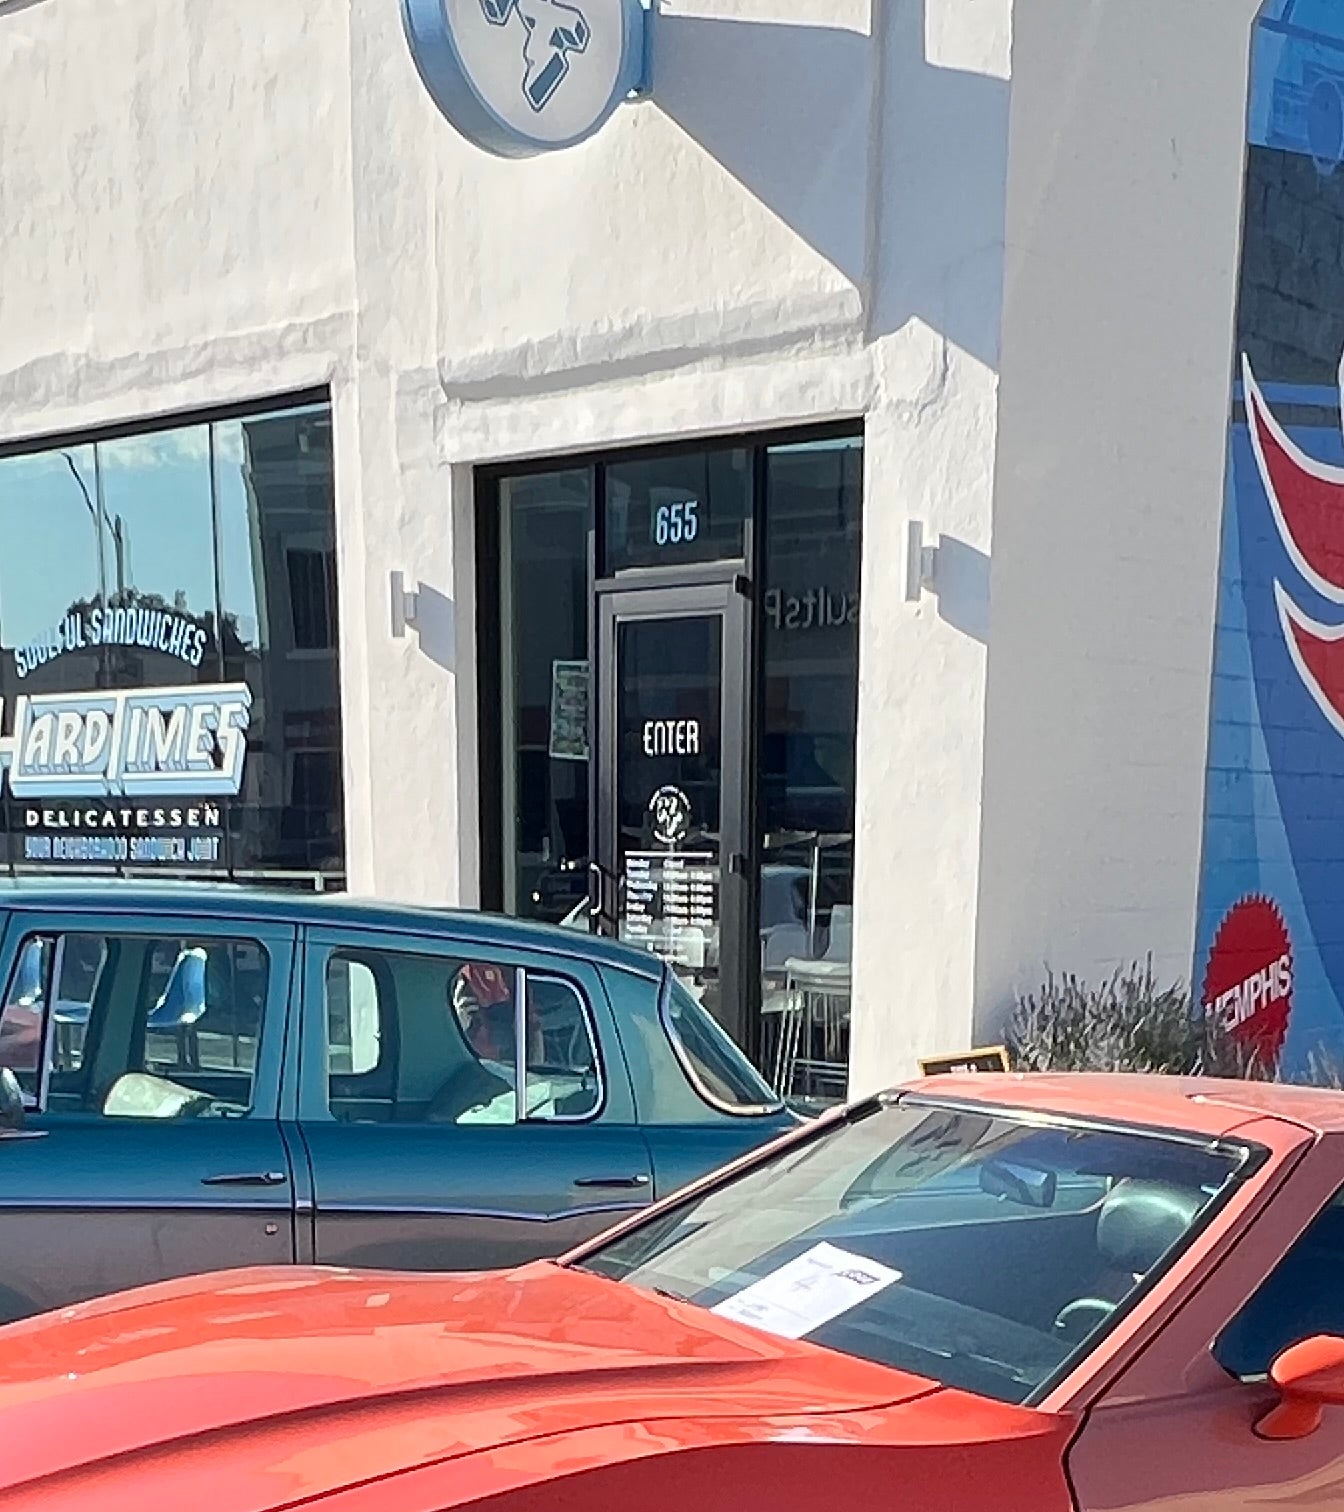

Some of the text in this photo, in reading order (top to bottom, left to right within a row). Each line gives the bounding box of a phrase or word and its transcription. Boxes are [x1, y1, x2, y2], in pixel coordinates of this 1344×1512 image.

[656, 500, 699, 545] 655
[90, 608, 206, 667] SANDWICHES
[643, 720, 699, 755] ENTER
[25, 808, 220, 828] DELICATESSEN
